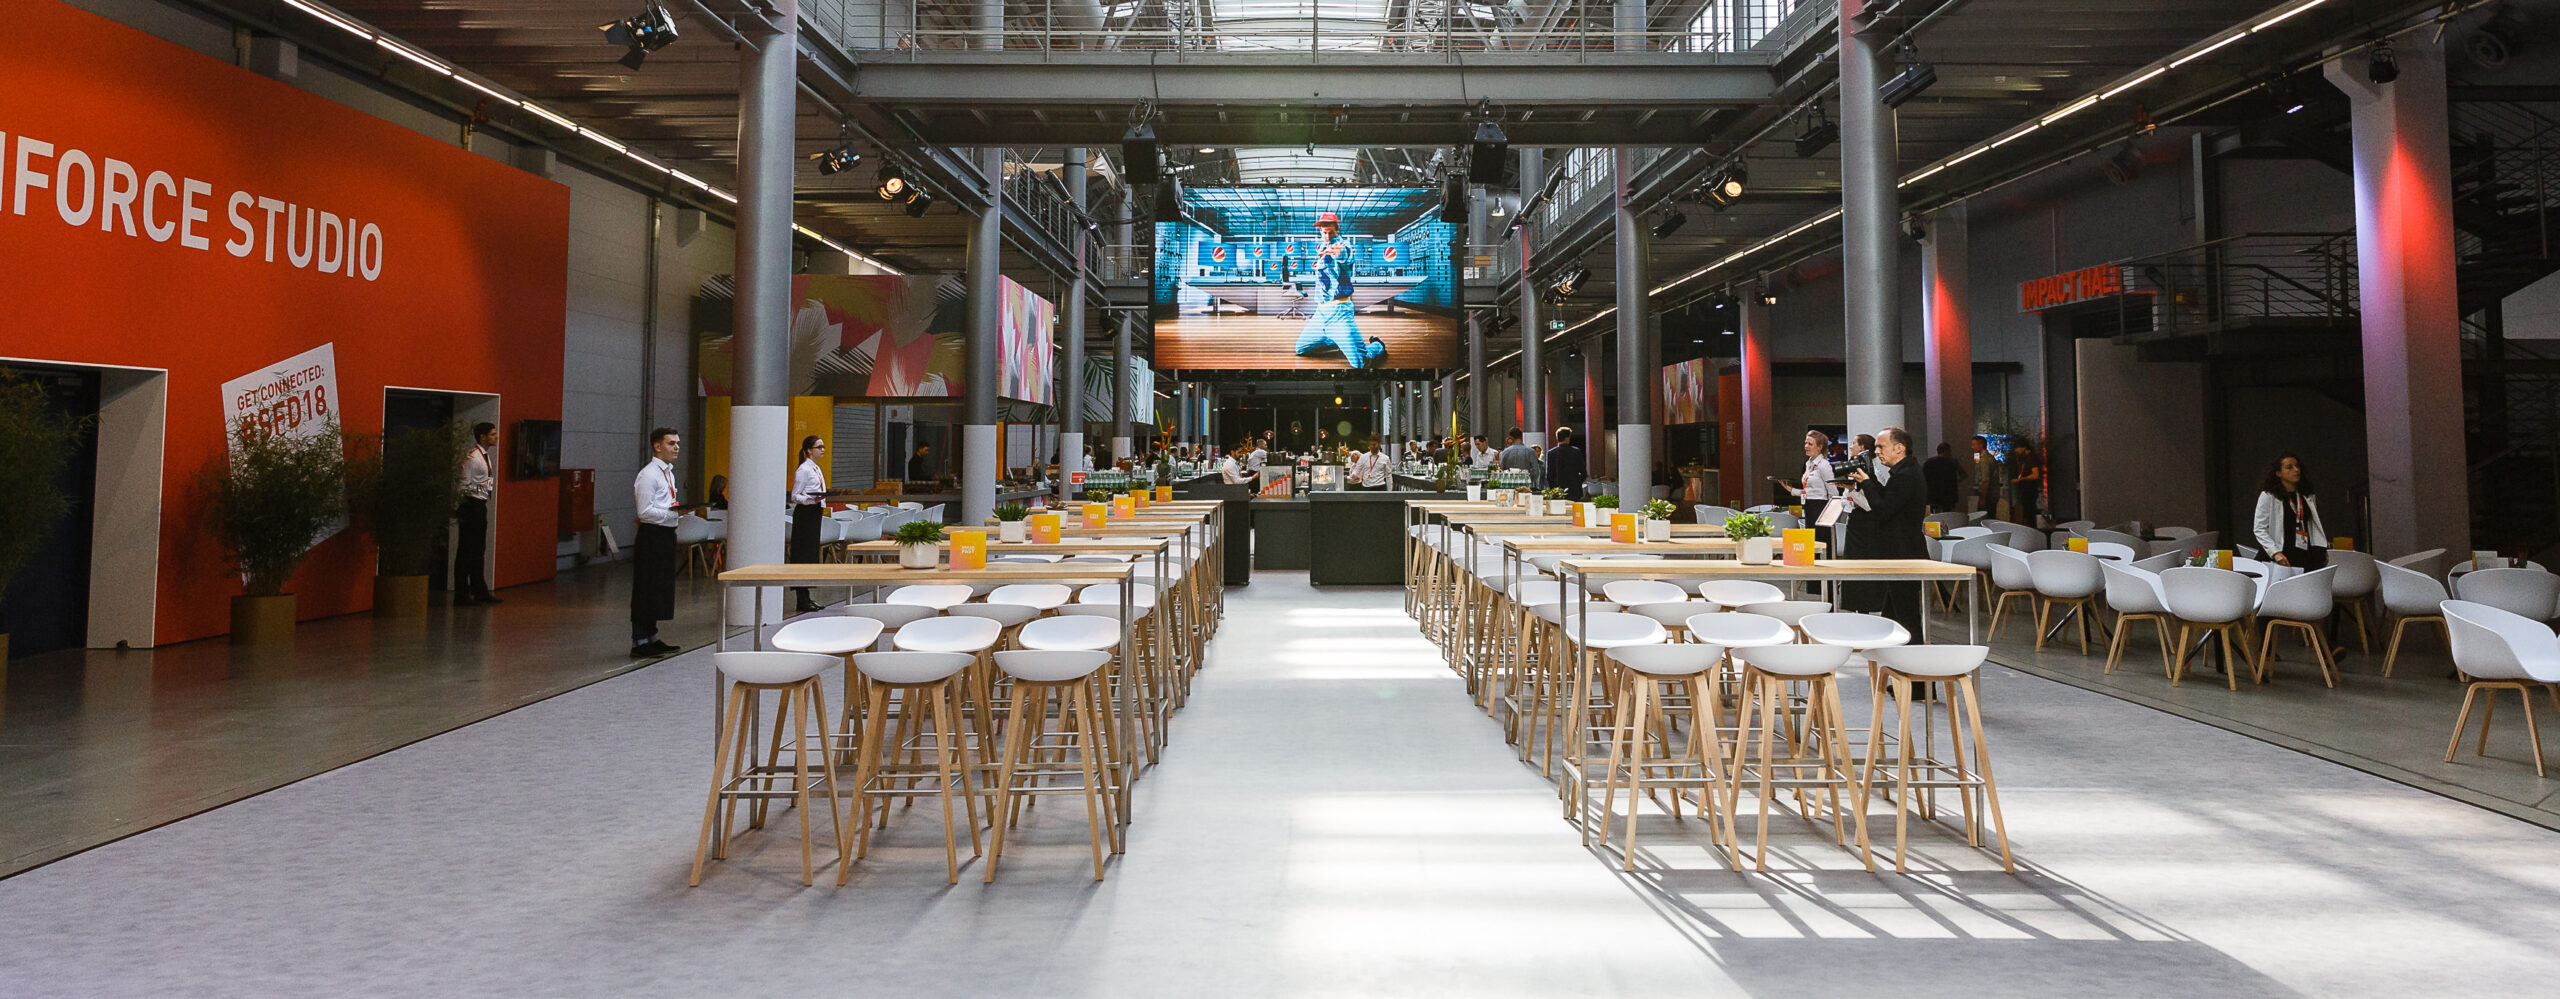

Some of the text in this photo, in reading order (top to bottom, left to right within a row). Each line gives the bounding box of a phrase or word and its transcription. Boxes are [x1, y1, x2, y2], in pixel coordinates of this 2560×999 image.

[0, 131, 383, 282] FORCE STUDIO
[2022, 264, 2122, 309] IMPACT HALL
[237, 365, 325, 410] GET CONNECTED:
